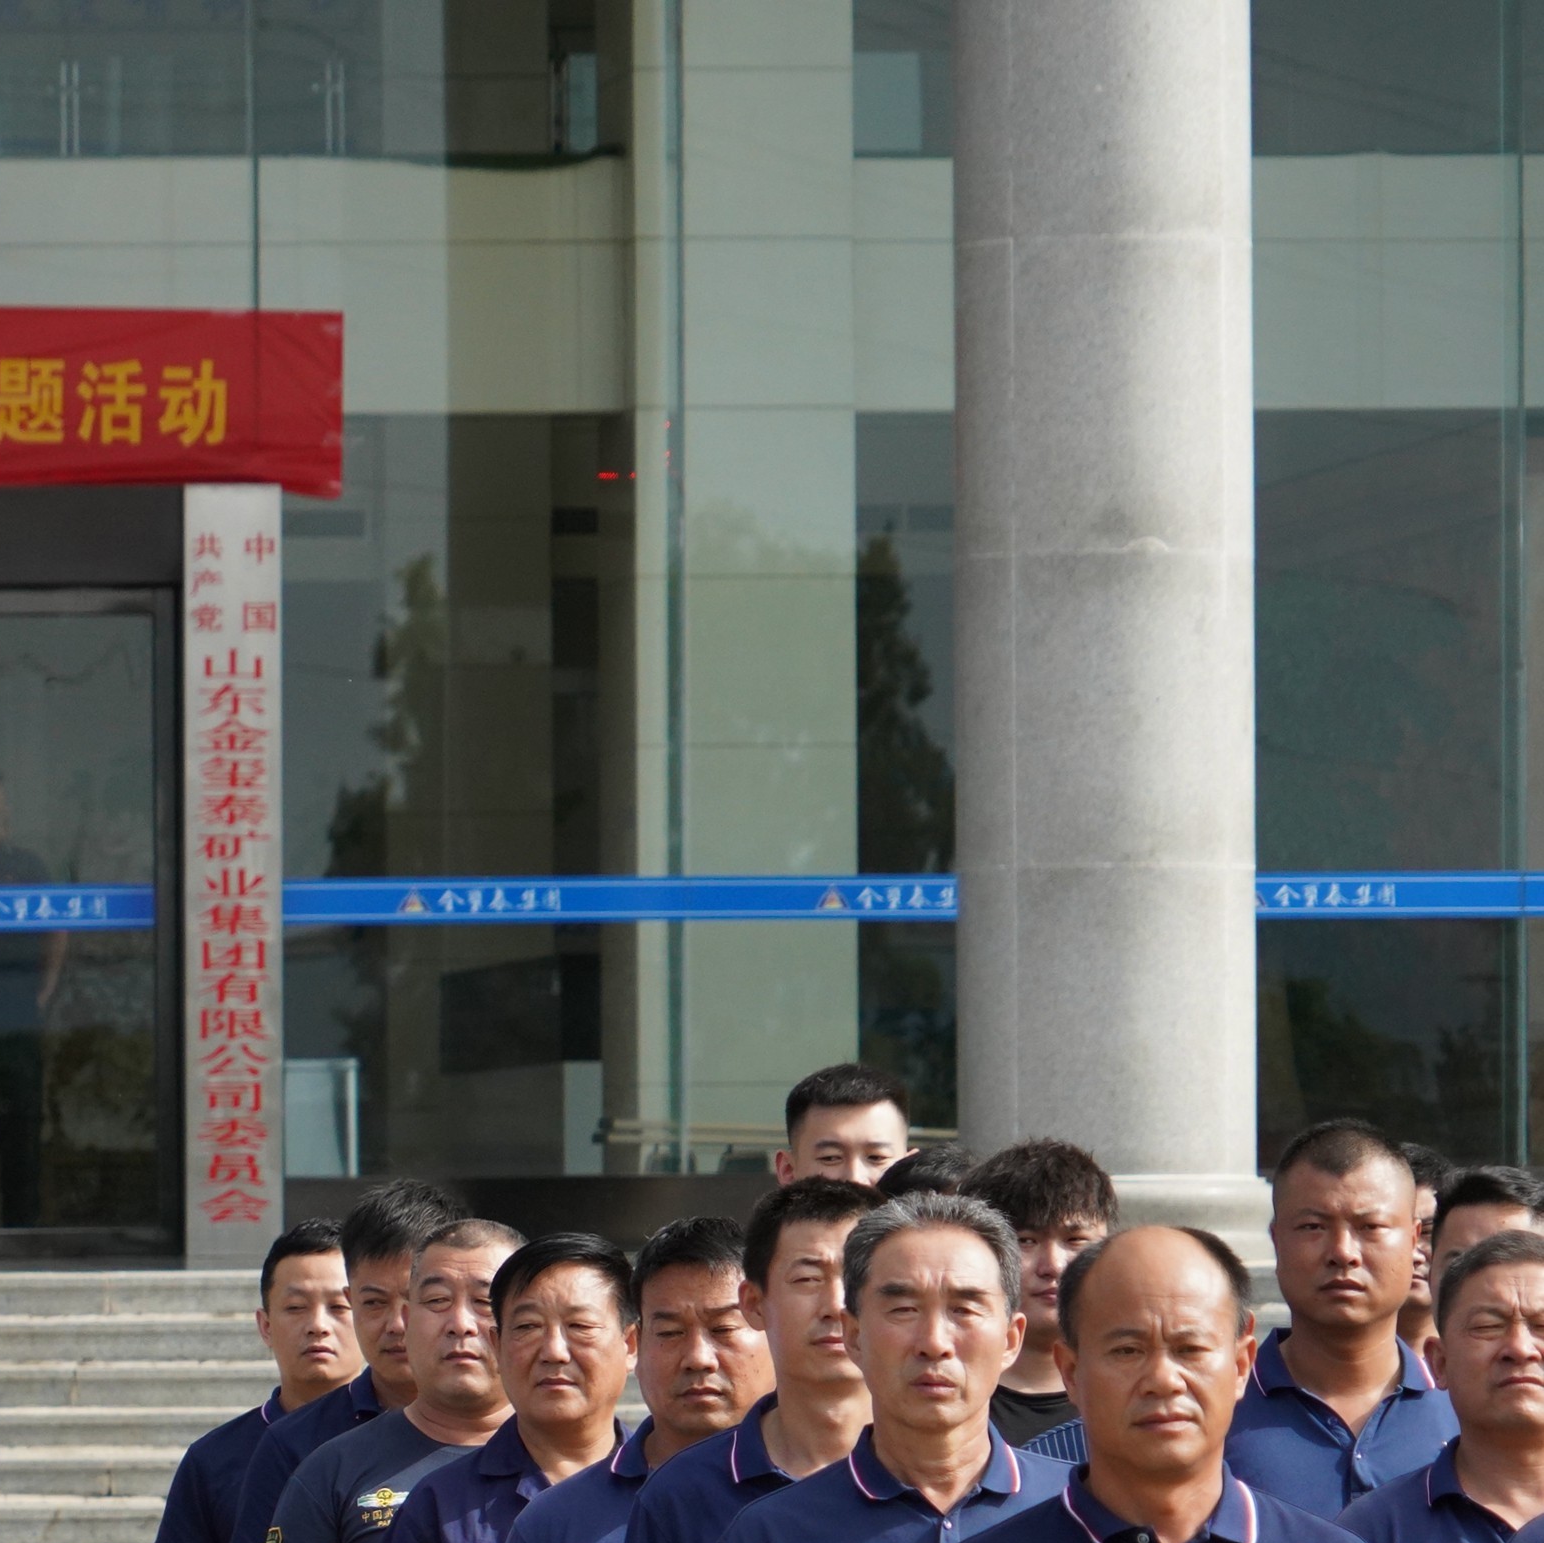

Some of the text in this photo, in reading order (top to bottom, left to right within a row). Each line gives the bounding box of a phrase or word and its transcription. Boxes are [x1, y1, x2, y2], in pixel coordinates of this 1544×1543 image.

[197, 648, 272, 1225] 山东金玺泰矿业集团有限公司委员会
